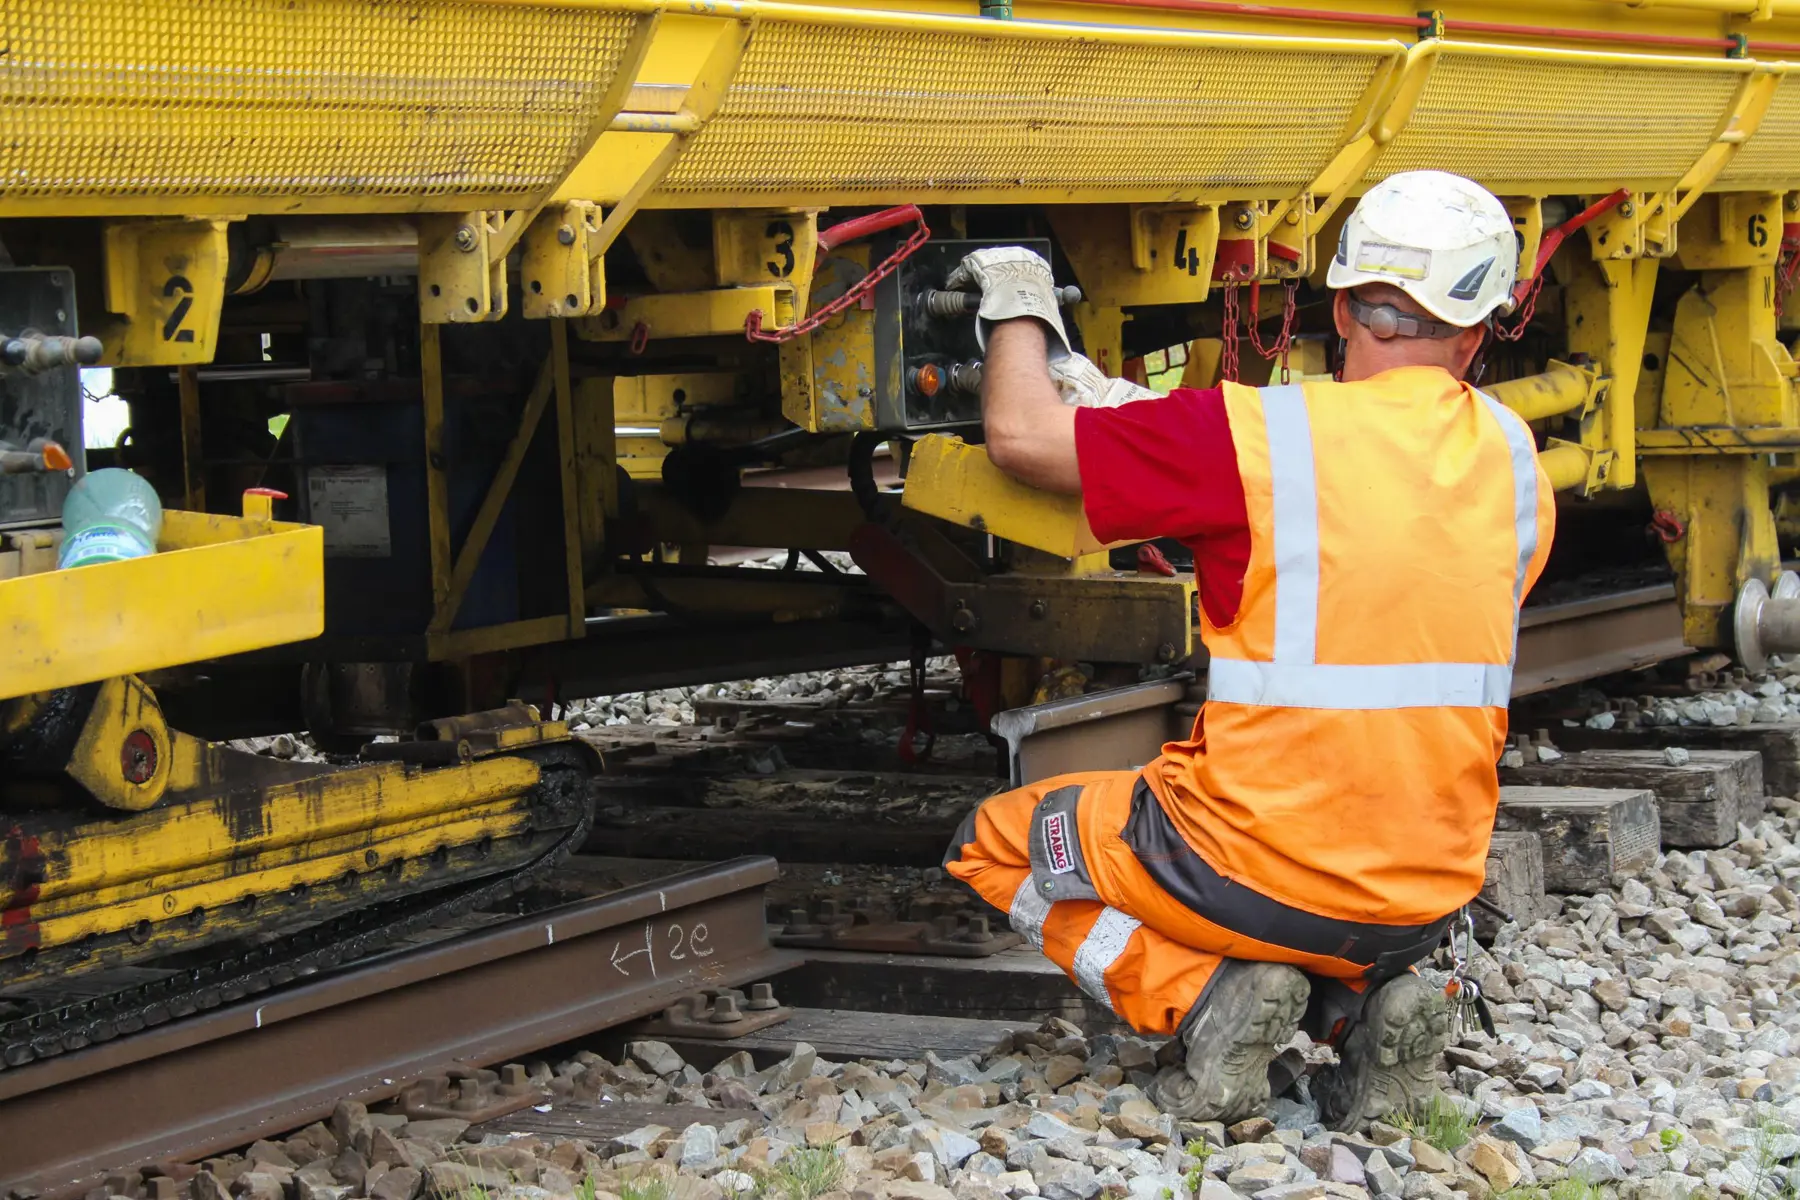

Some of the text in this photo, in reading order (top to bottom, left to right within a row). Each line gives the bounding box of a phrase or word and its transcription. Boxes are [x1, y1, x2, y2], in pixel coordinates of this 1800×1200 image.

[766, 221, 795, 279] 3
[1173, 229, 1200, 277] 4
[1748, 212, 1768, 248] 6
[163, 274, 195, 343] 2
[1049, 816, 1067, 869] STRABAG
